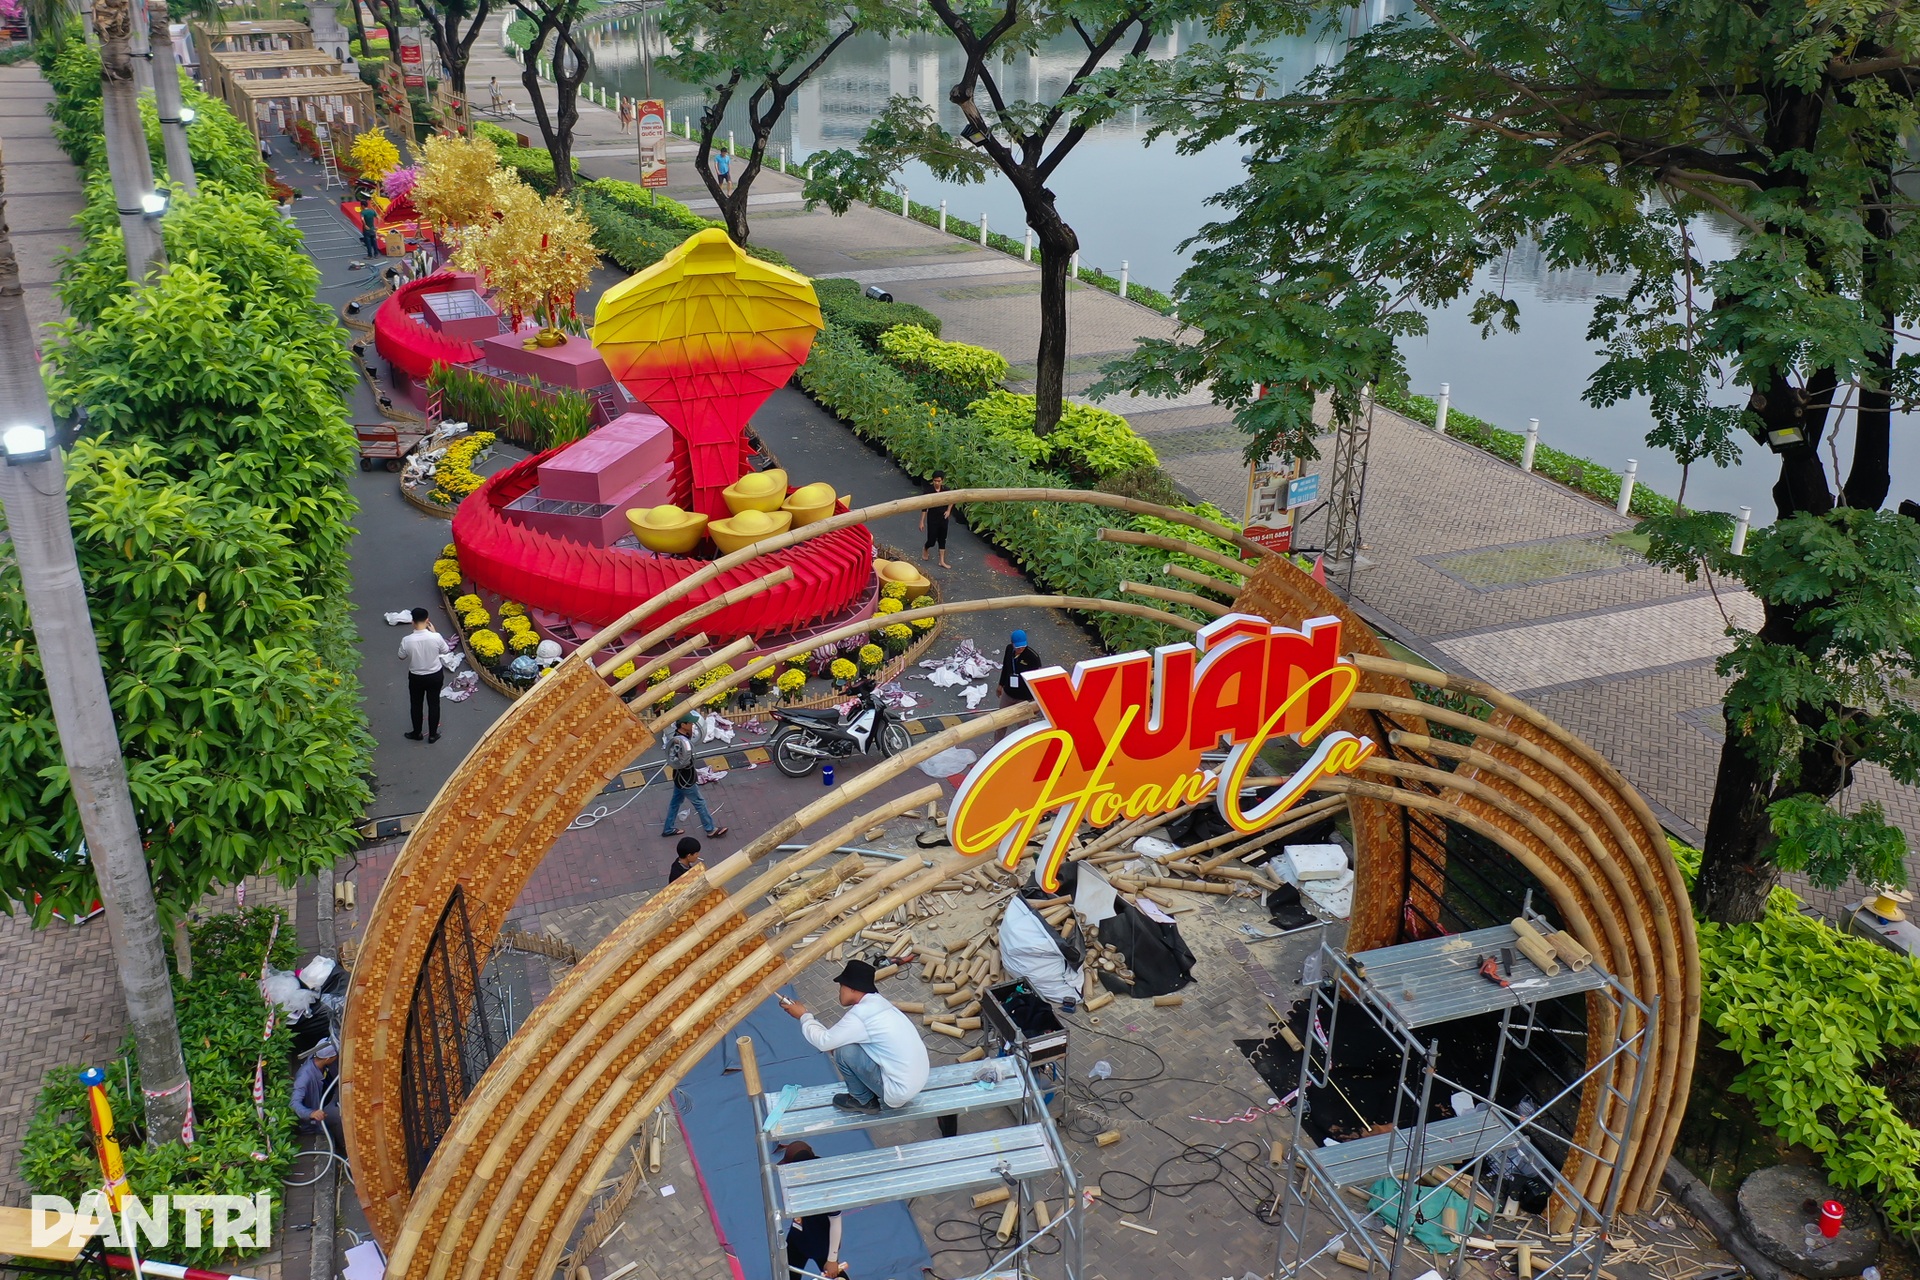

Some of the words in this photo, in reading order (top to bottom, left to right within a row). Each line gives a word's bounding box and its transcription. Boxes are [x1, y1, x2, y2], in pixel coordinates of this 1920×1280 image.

[951, 702, 1218, 893] Hoan
[1225, 663, 1376, 832] Ca
[1030, 617, 1341, 783] XUÂN
